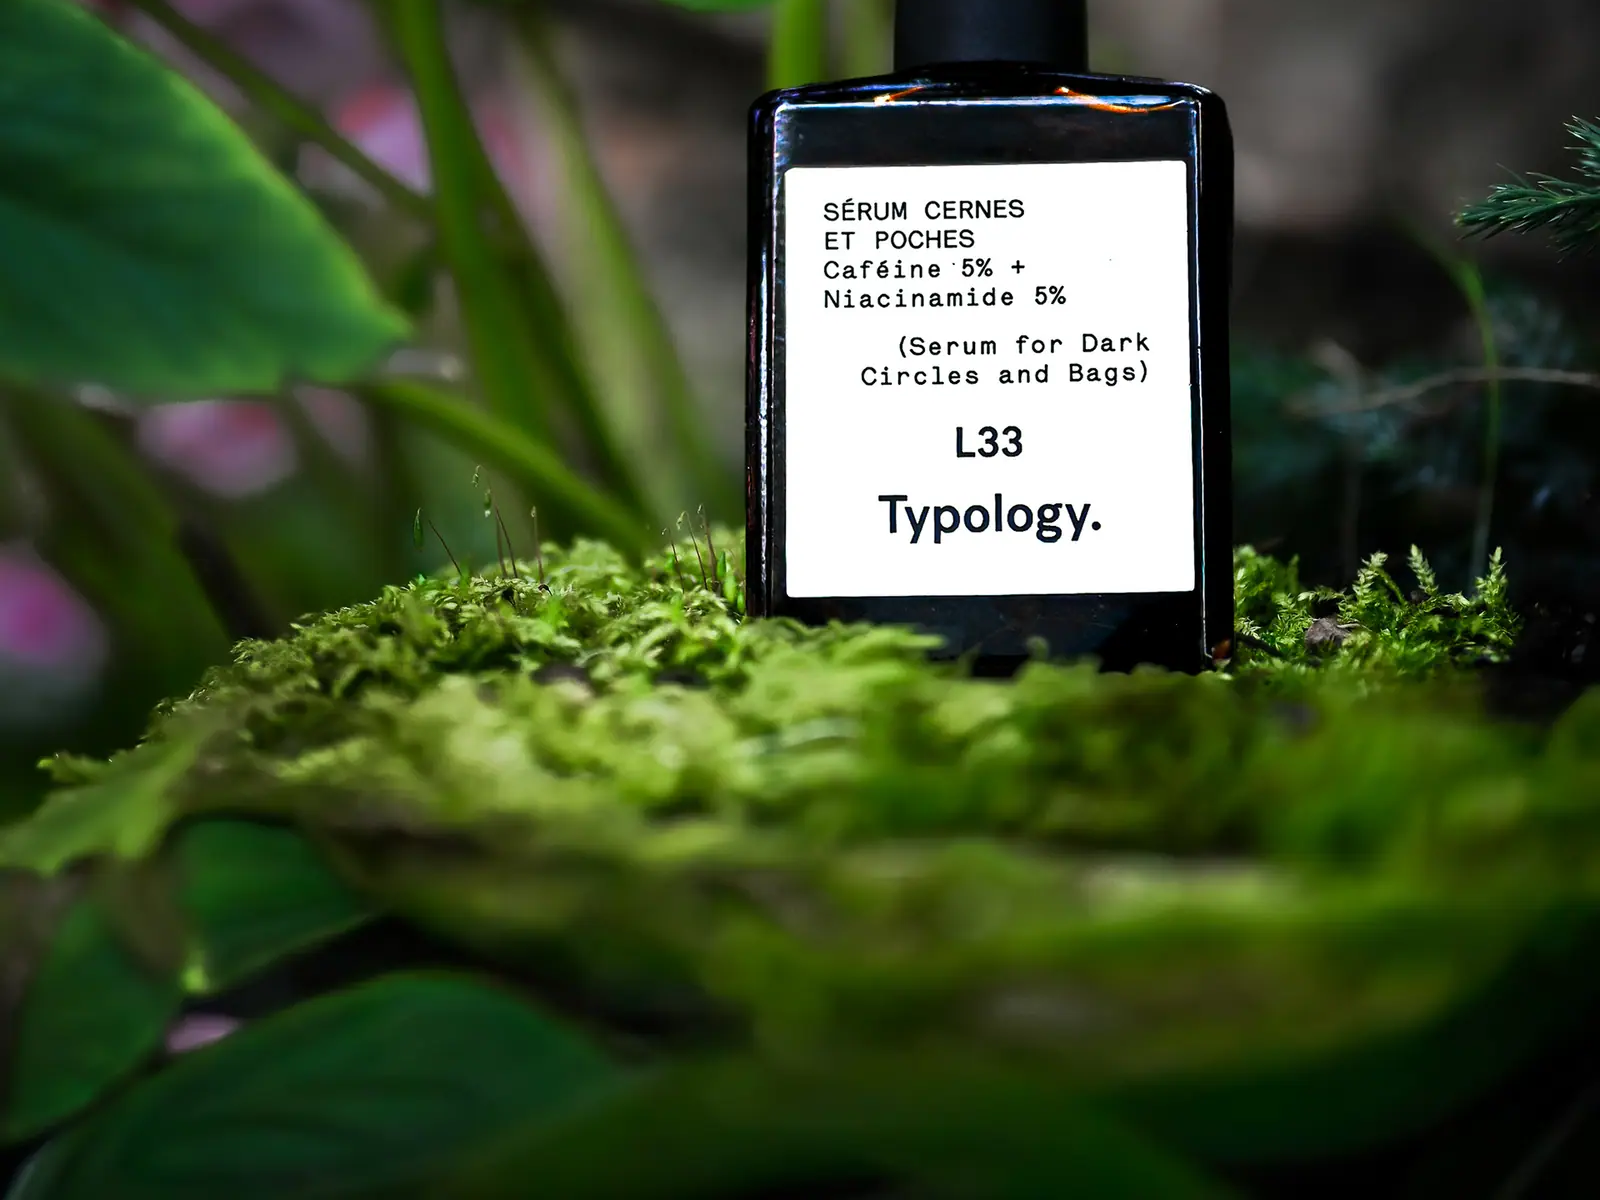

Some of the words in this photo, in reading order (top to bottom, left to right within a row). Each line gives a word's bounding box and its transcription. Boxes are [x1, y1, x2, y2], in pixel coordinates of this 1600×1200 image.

[823, 197, 907, 222] SÉRUM
[924, 198, 1025, 220] CERNES
[825, 231, 856, 251] ET
[875, 228, 975, 250] POCHES
[823, 259, 941, 280] Caféine
[960, 257, 994, 278] 5%
[824, 286, 1014, 309] Niacinamide
[1034, 285, 1067, 306] 5%
[898, 335, 998, 359] (Serum
[1015, 334, 1063, 355] for
[1082, 331, 1150, 354] Dark
[860, 365, 979, 387] Circles
[998, 363, 1049, 385] and
[1069, 359, 1149, 387] Bags)
[955, 425, 1024, 460] L33
[877, 492, 1102, 545] Typology.
